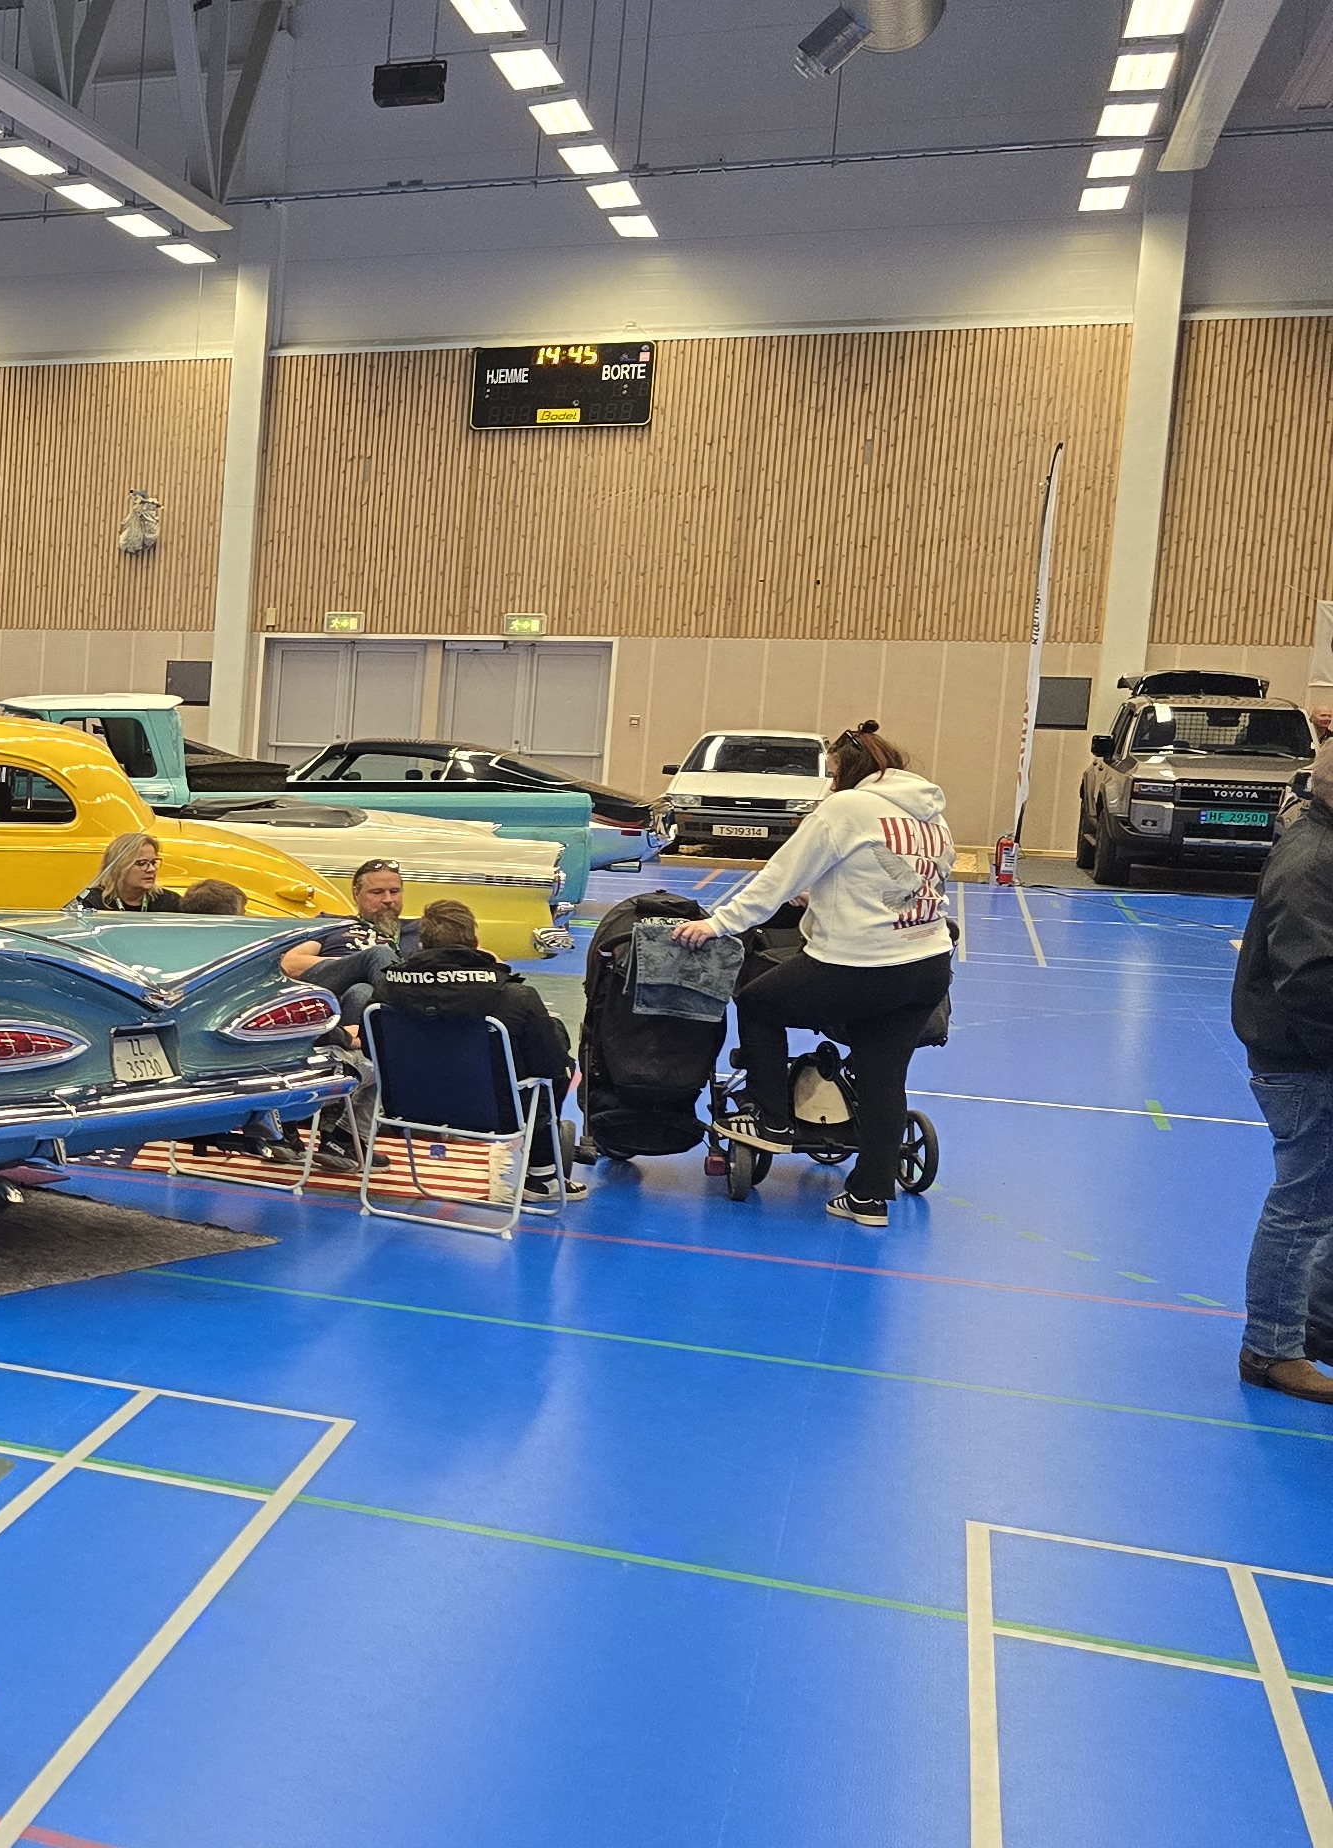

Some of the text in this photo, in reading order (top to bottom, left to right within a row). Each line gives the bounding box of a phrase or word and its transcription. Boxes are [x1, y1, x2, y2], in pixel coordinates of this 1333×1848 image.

[536, 345, 598, 365] 14:45
[486, 368, 530, 384] HJEMME
[601, 363, 647, 381] BORTE
[539, 411, 577, 421] Bodet
[1213, 789, 1259, 799] TOYOTA
[1209, 811, 1267, 824] HF 29500
[385, 969, 497, 984] CHAOTIC SYSTEM
[126, 1038, 145, 1056] ZZ
[126, 1058, 163, 1079] 35730
